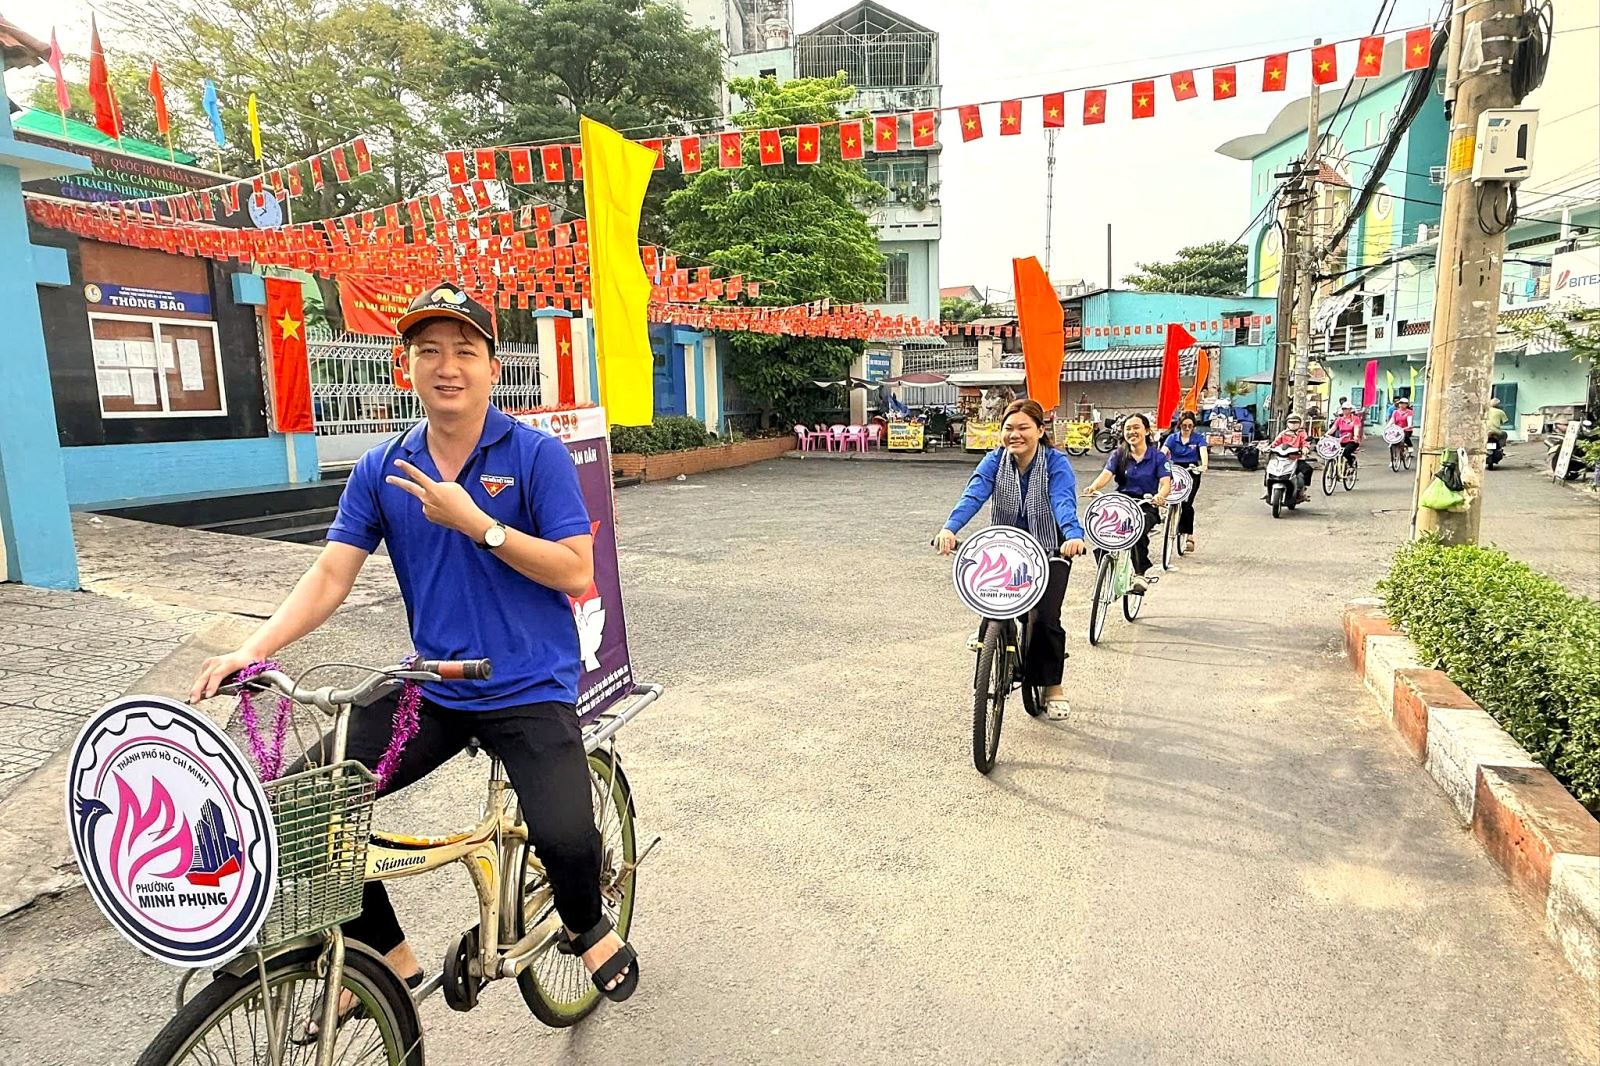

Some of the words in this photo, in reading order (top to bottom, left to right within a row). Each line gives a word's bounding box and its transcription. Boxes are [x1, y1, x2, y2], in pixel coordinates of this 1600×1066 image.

[109, 295, 157, 309] THÔNG
[159, 298, 185, 311] BÁO
[117, 752, 141, 771] THÀNH
[141, 748, 158, 759] PHỐ
[159, 750, 171, 761] HỒ
[173, 756, 187, 769] CHÍ
[187, 765, 209, 788] MINH
[373, 855, 426, 873] Shimano
[136, 881, 175, 893] PHƯỜNG
[138, 894, 176, 909] MINH
[178, 892, 228, 910] PHỤNG
